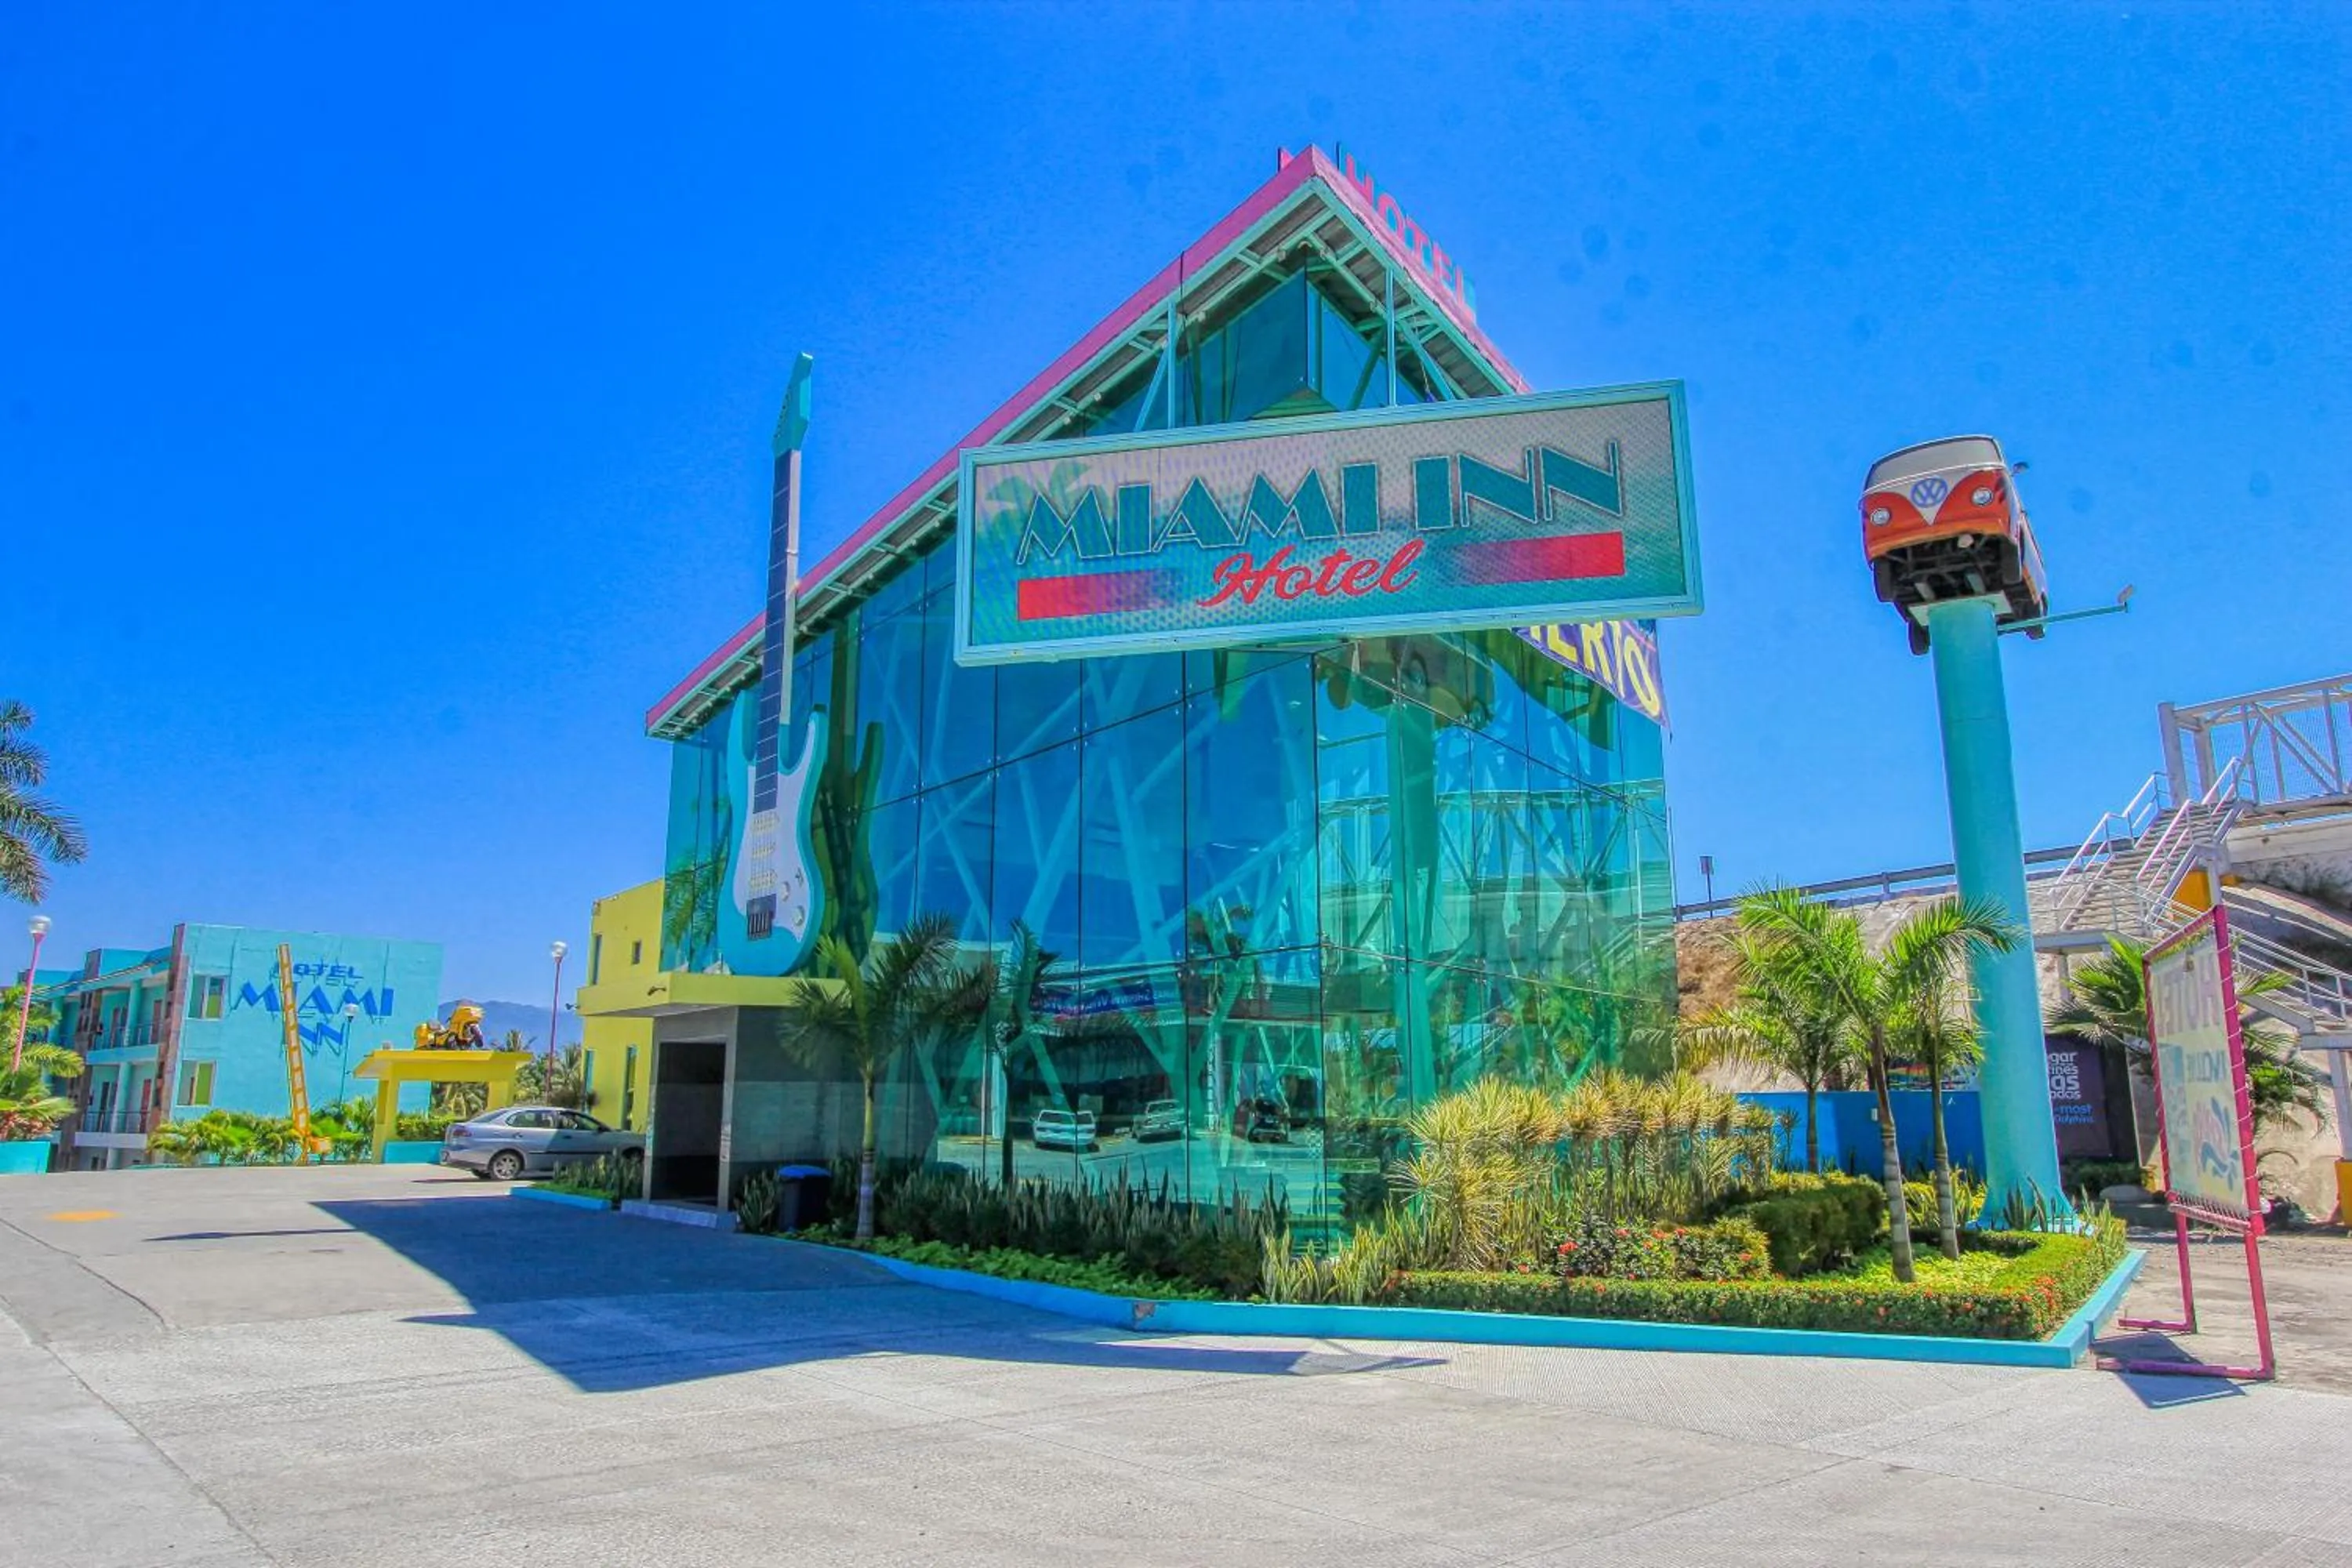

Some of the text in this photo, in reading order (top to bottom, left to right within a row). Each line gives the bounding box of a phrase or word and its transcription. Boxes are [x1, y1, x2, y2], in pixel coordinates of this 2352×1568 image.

[1018, 441, 1623, 565] MIAMI INN
[1196, 539, 1425, 606] Hotel
[234, 982, 394, 1017] MAMI
